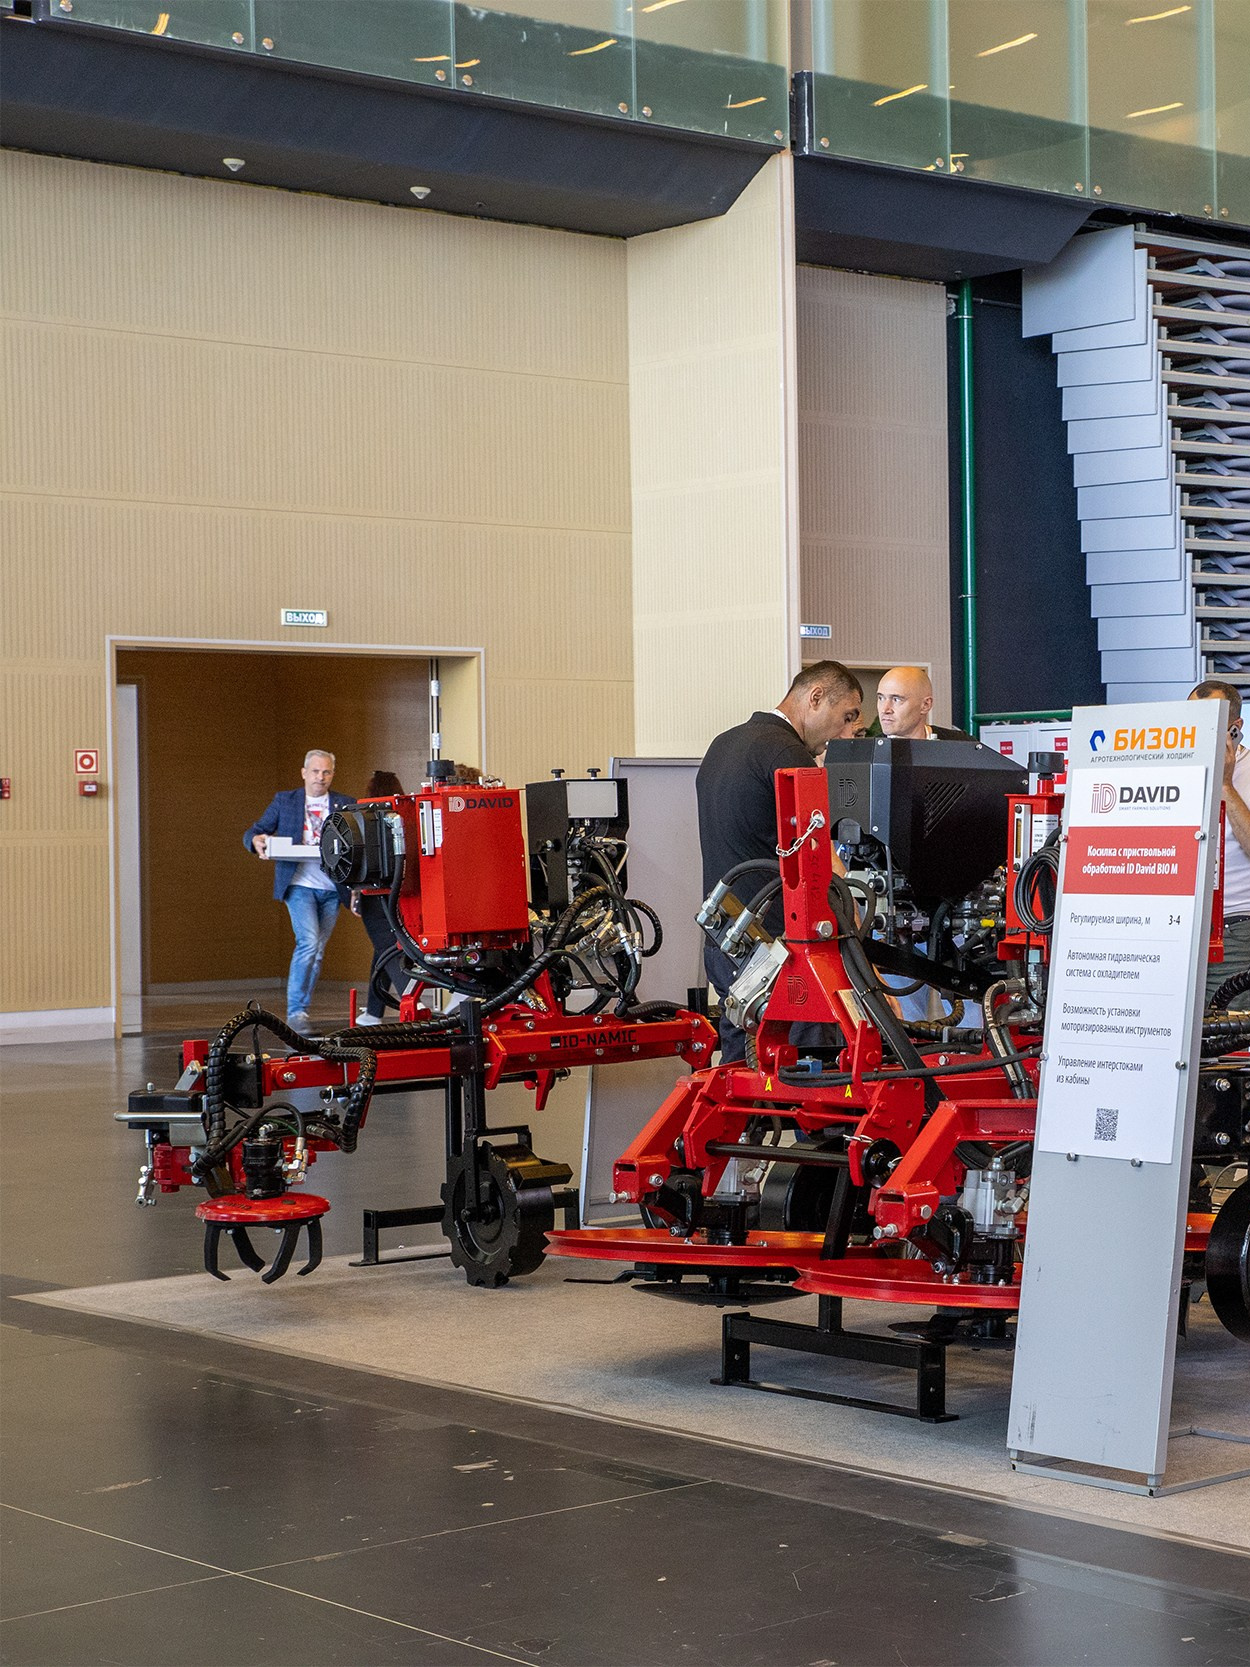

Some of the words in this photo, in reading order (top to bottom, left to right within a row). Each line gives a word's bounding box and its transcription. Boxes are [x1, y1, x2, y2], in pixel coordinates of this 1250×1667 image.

[287, 612, 324, 624] ВЫХОД
[1114, 726, 1196, 751] БИЗОН
[1090, 752, 1164, 763] АГРОТЕХНОЛОГИЧЕСКИЙ
[1166, 752, 1194, 760] ХОЛДИНГ
[1119, 786, 1180, 803] DAVID
[466, 798, 513, 808] DAVID
[1088, 846, 1116, 857] Косилка
[1118, 848, 1122, 856] с
[1123, 846, 1176, 859] приствольной
[1082, 862, 1126, 876] обработкой
[1126, 863, 1134, 874] ID
[1136, 863, 1156, 874] David
[1156, 863, 1170, 874] BIO
[1170, 864, 1178, 874] M
[1070, 912, 1114, 926] Регулируемая
[1116, 914, 1144, 926] ширина,
[1144, 916, 1150, 924] м
[1168, 914, 1180, 925] 3-4
[1067, 950, 1106, 961] Автономная
[1108, 952, 1160, 964] гидравлическая
[1066, 968, 1092, 978] система
[1092, 969, 1096, 978] с
[1097, 969, 1140, 980] охладителем
[1062, 1002, 1106, 1016] Возможность
[1107, 1006, 1141, 1018] установки
[1061, 1022, 1124, 1034] моторизированных
[1125, 1026, 1172, 1038] инструментов
[561, 1030, 636, 1048] ID-NAMIC
[1058, 1055, 1096, 1069] Управление
[1096, 1060, 1144, 1072] интерстоками
[1056, 1074, 1064, 1084] из
[1066, 1073, 1090, 1085] кабины
